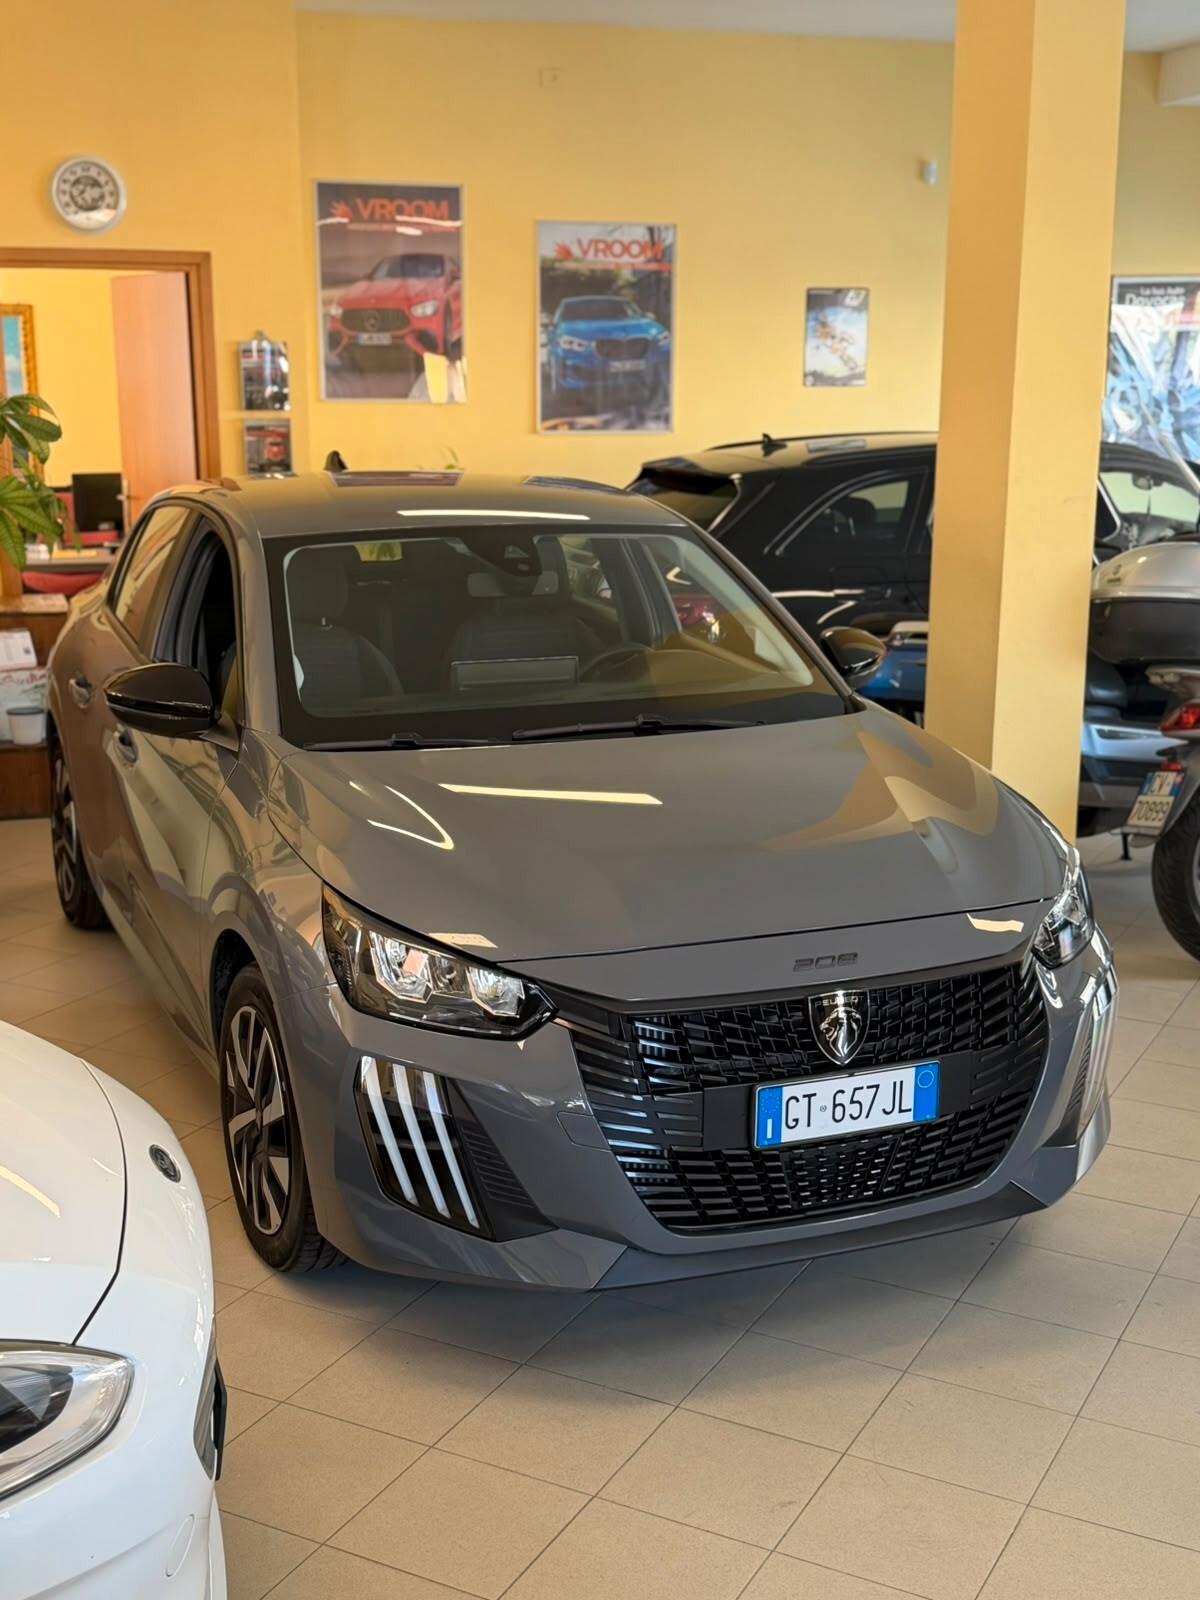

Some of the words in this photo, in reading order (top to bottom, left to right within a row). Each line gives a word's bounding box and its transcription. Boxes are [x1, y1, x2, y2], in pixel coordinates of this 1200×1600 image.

[355, 197, 449, 221] VROOM
[576, 238, 664, 260] VROOM
[793, 952, 858, 972] 208
[784, 1092, 817, 1130] GT
[831, 1084, 880, 1123] 657
[882, 1080, 912, 1115] JL
